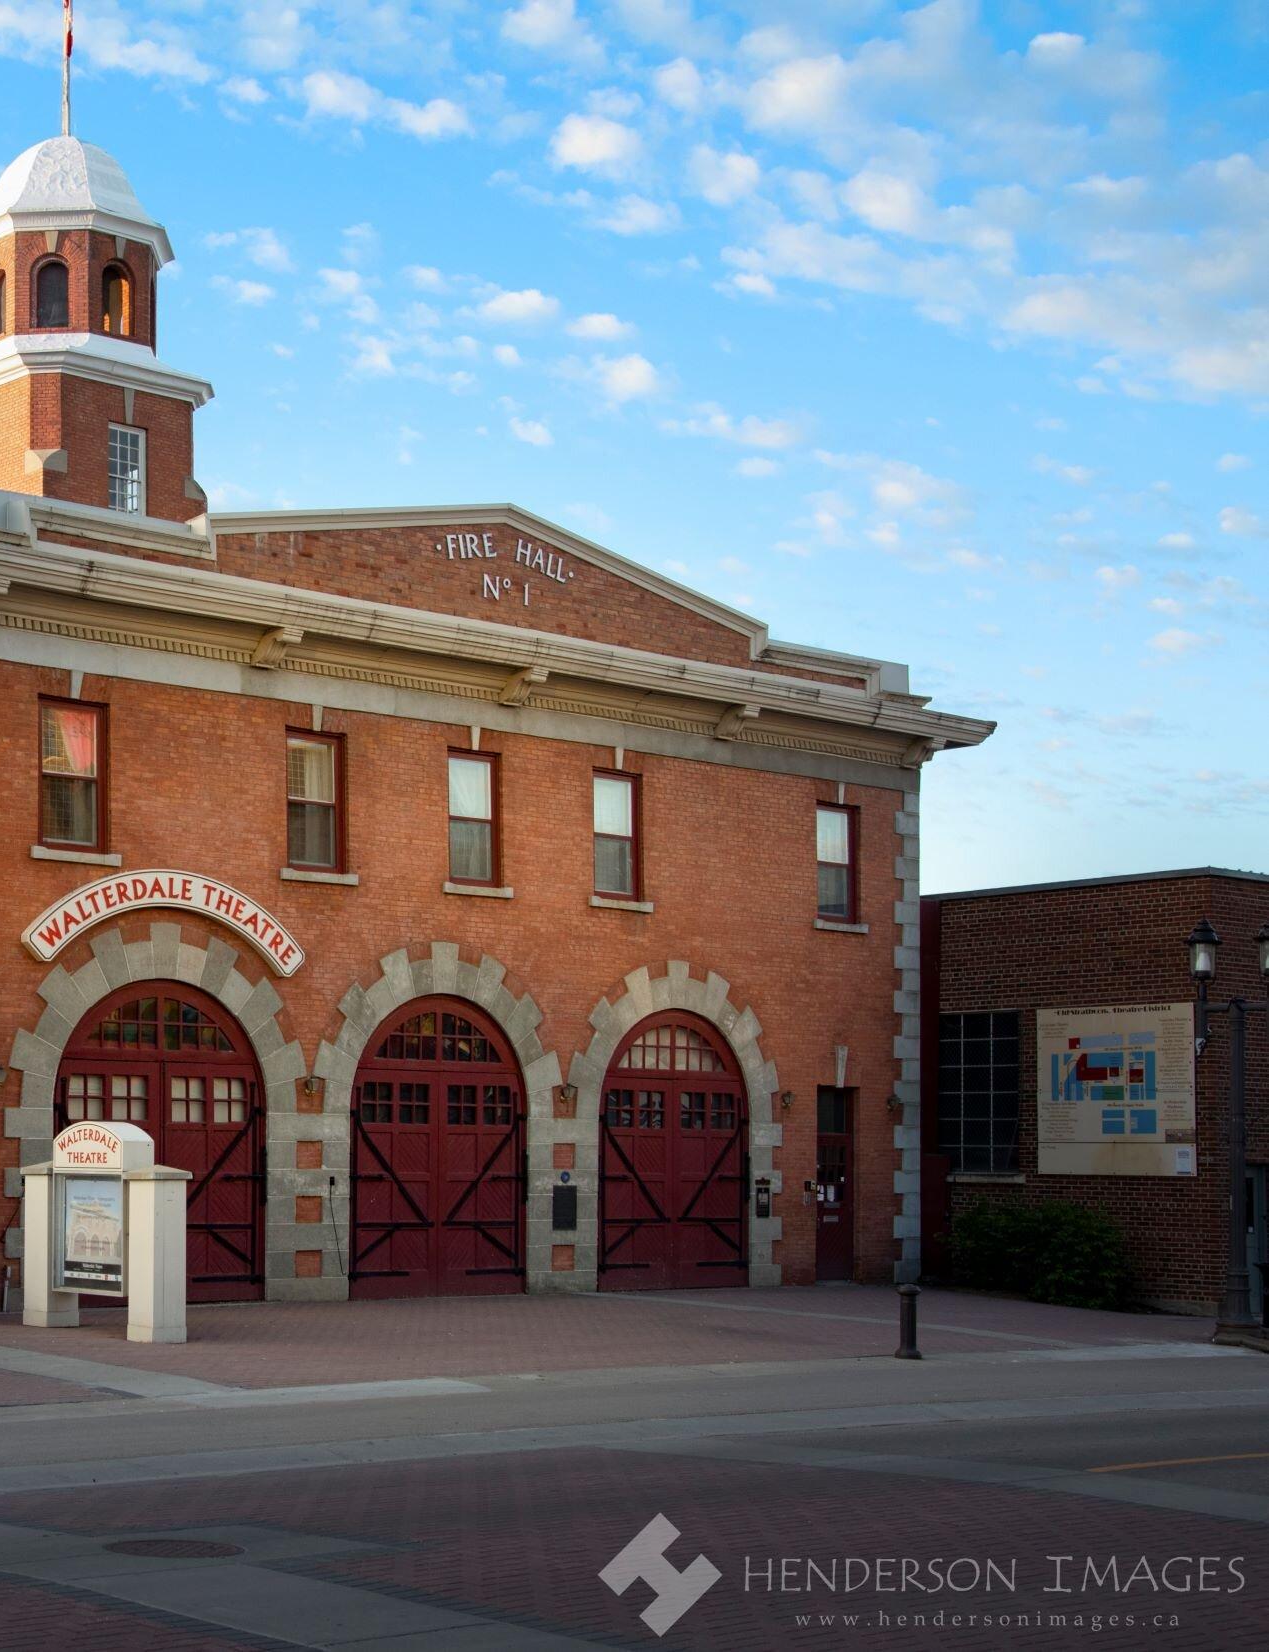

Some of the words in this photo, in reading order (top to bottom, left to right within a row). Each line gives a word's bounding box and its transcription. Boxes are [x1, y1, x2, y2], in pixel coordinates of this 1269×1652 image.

[445, 532, 498, 560] FIRE
[516, 538, 567, 584] HALL
[37, 876, 193, 948] WALTERDALE
[202, 883, 297, 967] THEATRE
[58, 1128, 119, 1154] WALTERDALE
[67, 1151, 108, 1164] THEATRE
